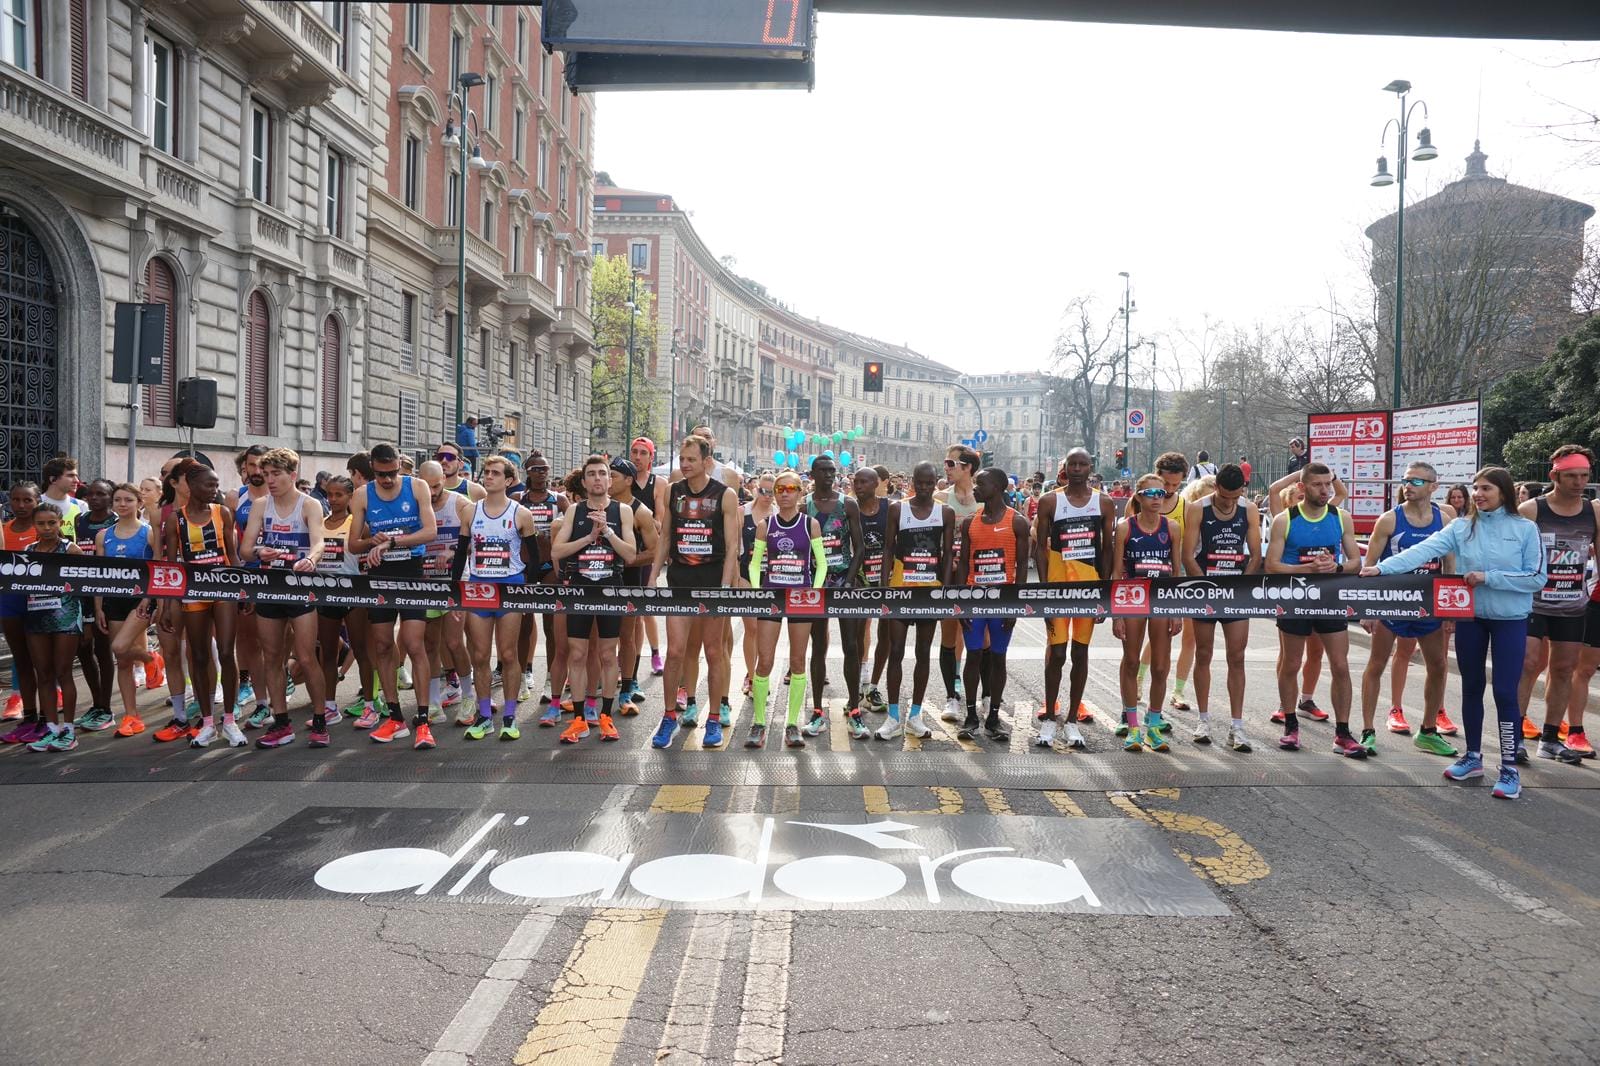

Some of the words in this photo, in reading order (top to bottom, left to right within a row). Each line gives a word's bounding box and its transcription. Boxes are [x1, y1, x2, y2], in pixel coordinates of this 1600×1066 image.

[1355, 420, 1384, 438] 50
[1212, 534, 1223, 542] PRO
[1224, 533, 1241, 541] PATRIA
[588, 560, 605, 569] 285
[60, 566, 140, 580] ESSELUNGA
[153, 568, 183, 586] 50
[194, 571, 240, 584] BANCO
[244, 574, 268, 585] BPM
[370, 580, 450, 592] ESSELUNGA
[464, 584, 495, 598] 50
[507, 586, 554, 596] BANCO
[558, 587, 584, 596] BPM
[691, 590, 775, 599] ESSELUNGA
[789, 590, 820, 605] 50
[834, 590, 882, 600] BANCO
[886, 590, 912, 600] BPM
[930, 586, 1000, 600] diadora
[1018, 588, 1100, 599] ESSELUNGA
[1114, 586, 1146, 604] 50
[1158, 588, 1206, 599] BANCO
[1208, 588, 1234, 599] BPM
[1252, 576, 1320, 600] diadora
[1339, 590, 1423, 602] ESSELUNGA
[11, 583, 64, 592] Stramilano
[82, 585, 134, 594] Stramilano
[188, 590, 240, 598] Stramilano
[257, 592, 308, 602] Stramilano
[326, 595, 378, 604] Stramilano
[395, 598, 448, 606] Stramilano
[503, 601, 556, 610] Stramilano
[574, 603, 628, 612] Stramilano
[645, 604, 699, 613] Stramilano
[717, 606, 771, 614] Stramilano
[828, 606, 882, 615] Stramilano
[900, 606, 954, 615] Stramilano
[972, 606, 1026, 615] Stramilano
[1044, 606, 1097, 615] Stramilano
[1153, 606, 1206, 615] Stramilano
[1224, 606, 1277, 615] Stramilano
[1294, 607, 1347, 616] Stramilano
[1365, 608, 1419, 617] Stramilano
[1438, 590, 1470, 608] 50
[313, 812, 1102, 907] diadora
